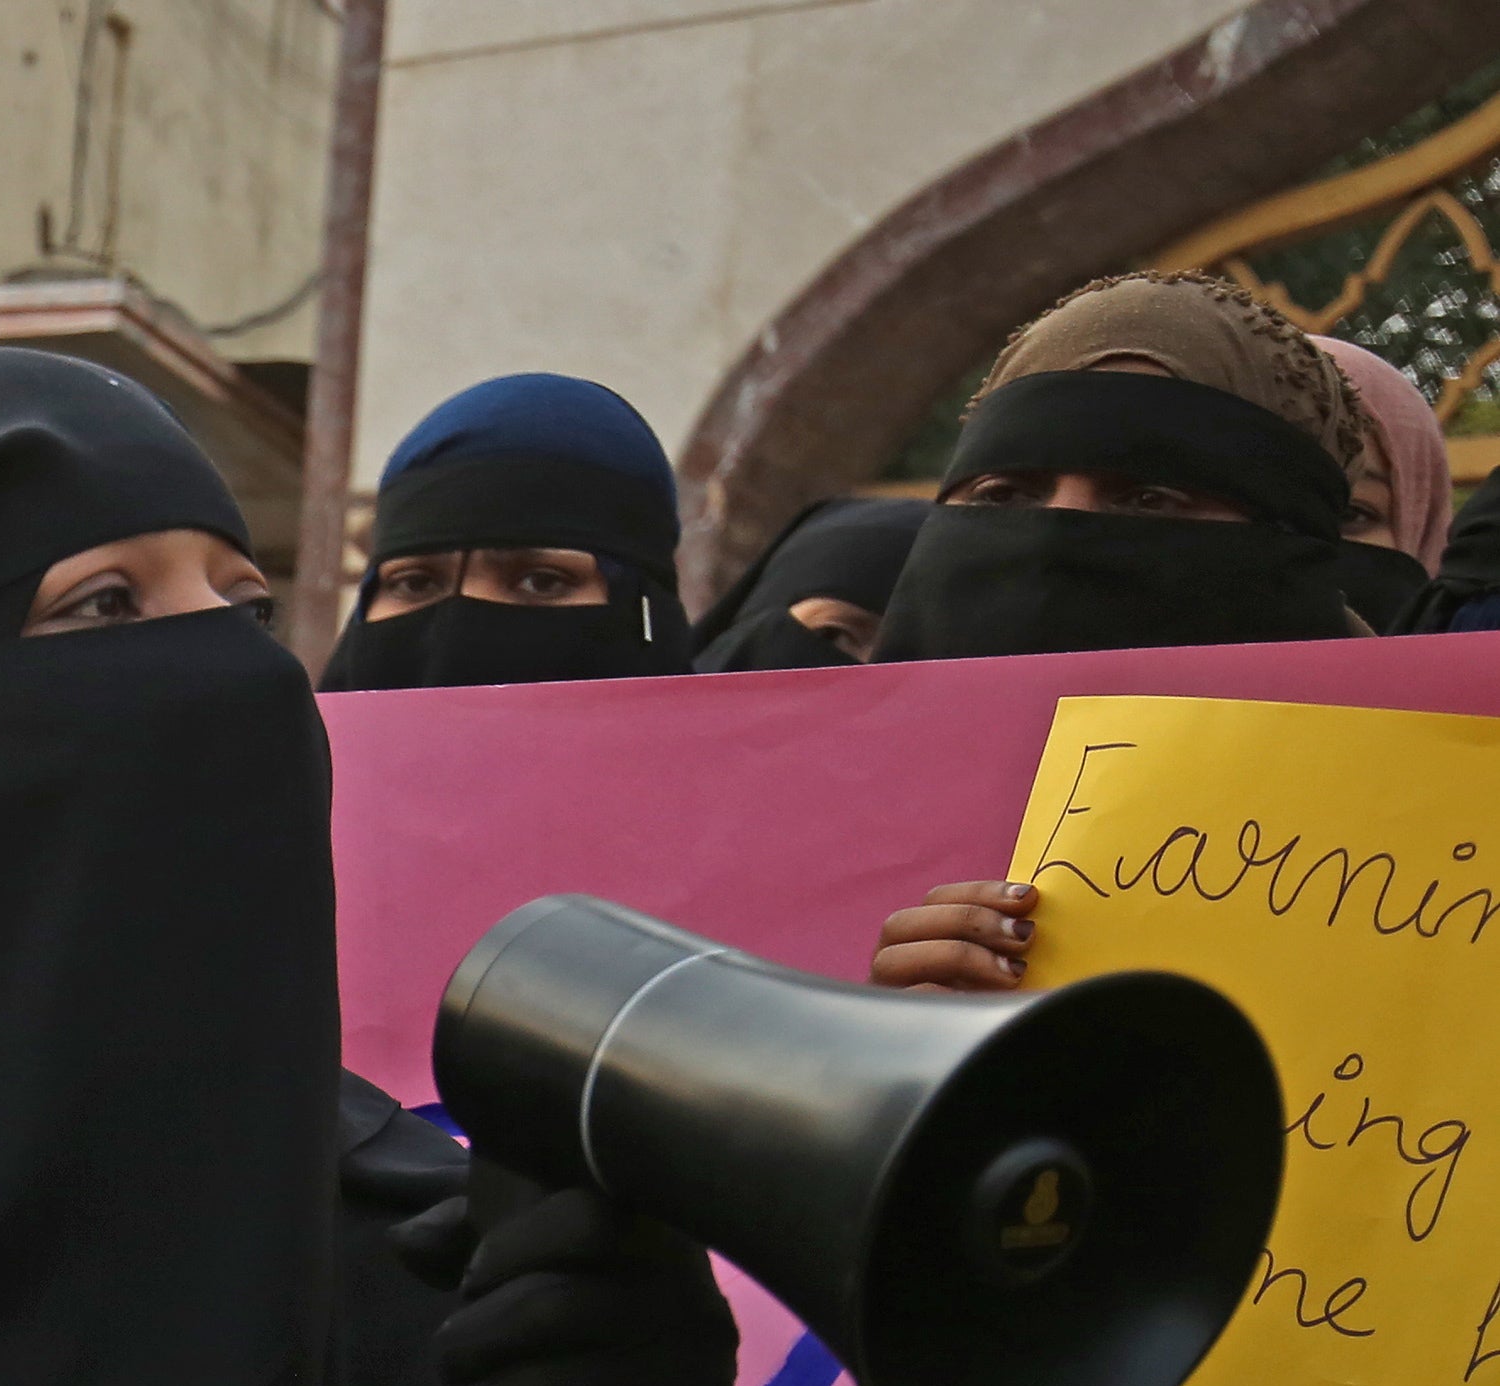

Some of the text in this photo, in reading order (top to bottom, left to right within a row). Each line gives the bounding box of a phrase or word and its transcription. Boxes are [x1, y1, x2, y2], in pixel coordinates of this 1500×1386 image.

[1031, 741, 1500, 945] Earnin
[1286, 1053, 1472, 1242] ing
[1255, 1248, 1375, 1337] ne
